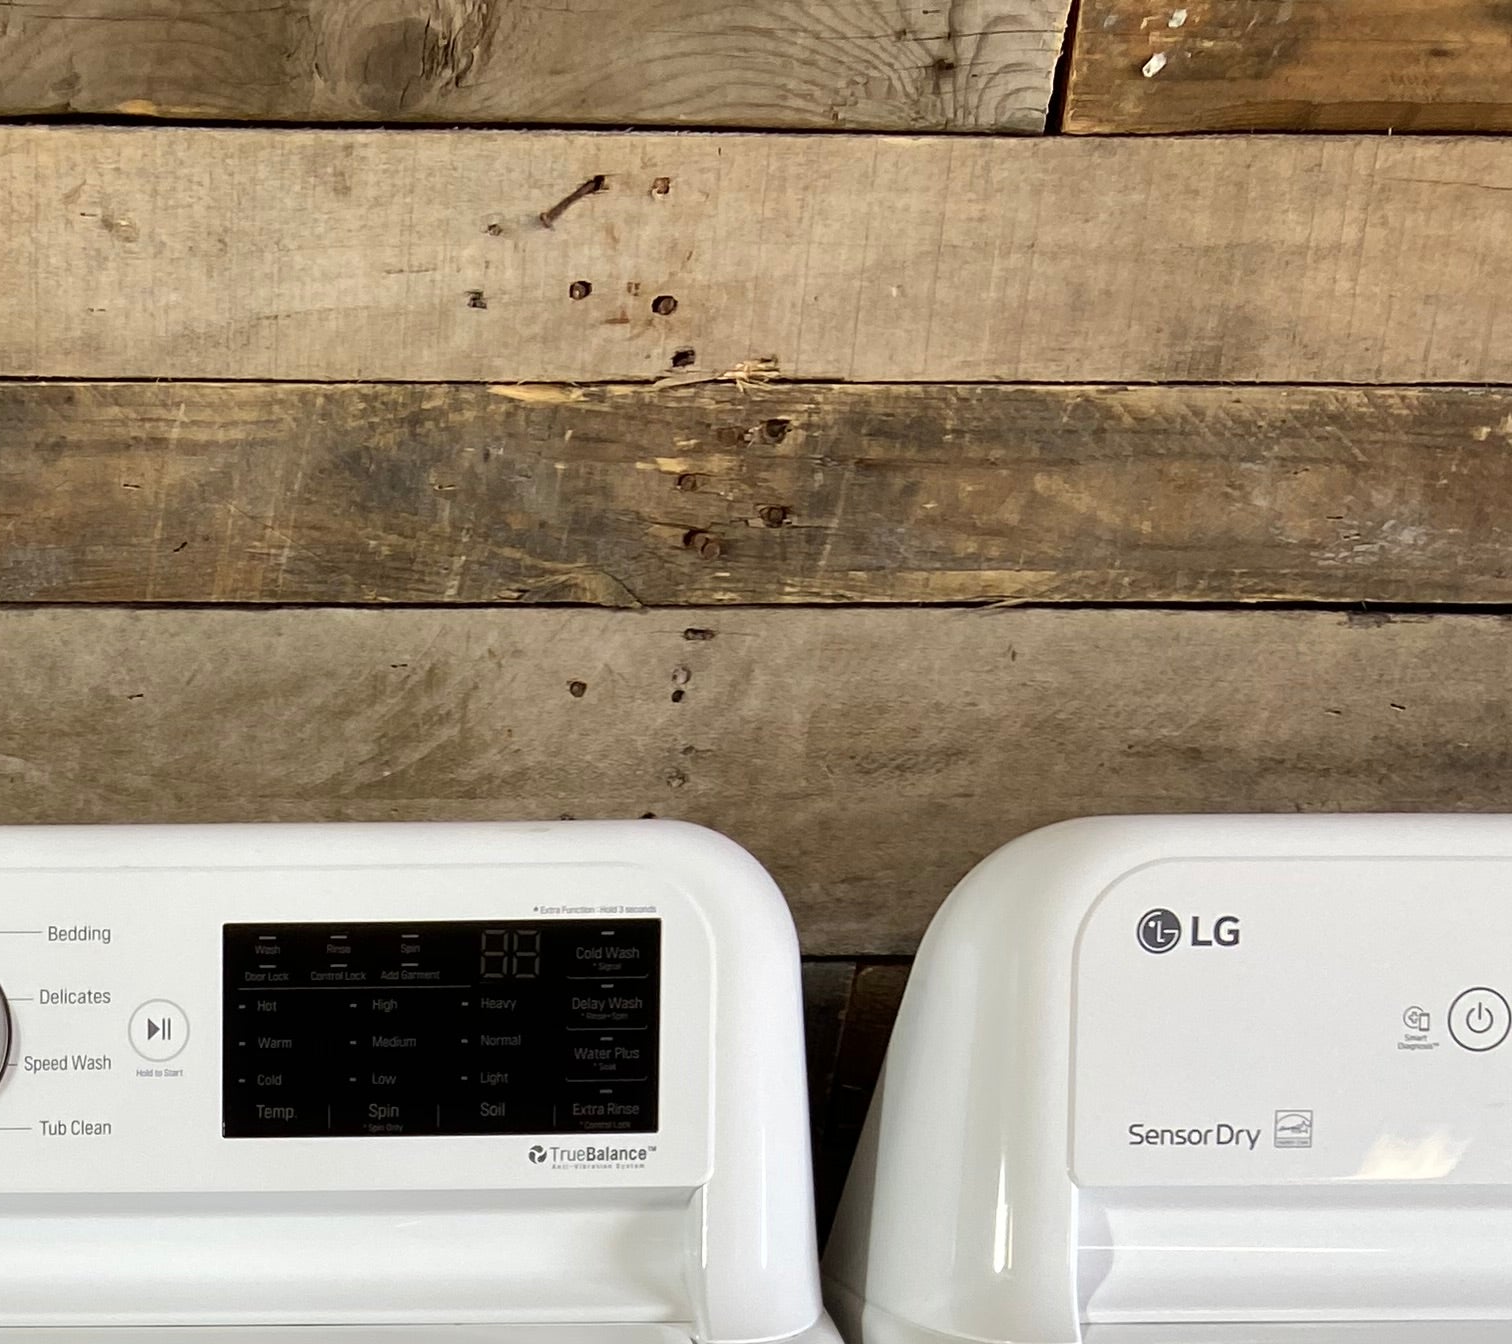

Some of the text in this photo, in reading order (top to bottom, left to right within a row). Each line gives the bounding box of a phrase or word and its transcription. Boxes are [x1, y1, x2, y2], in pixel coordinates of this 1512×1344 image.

[48, 926, 112, 944] Bedding
[1191, 915, 1240, 947] LG
[255, 945, 280, 954] Wash
[327, 944, 351, 954] Rinse
[401, 944, 421, 954] Spin
[576, 947, 640, 959] Cold Wash
[40, 989, 112, 1005] Delicates
[257, 1001, 277, 1012] Hot
[373, 1000, 398, 1012] High
[481, 998, 517, 1011] Heavy
[572, 997, 643, 1011] Delay Wash
[258, 1037, 292, 1049] Warm
[373, 1036, 416, 1048] Medium
[481, 1035, 521, 1046] Normal
[574, 1048, 640, 1060] Water Plus
[24, 1055, 112, 1074] Speed Wash
[136, 1069, 153, 1077] Hold
[164, 1069, 183, 1077] Start
[480, 1072, 508, 1085] Light
[257, 1075, 282, 1086] Cold
[372, 1074, 397, 1085] Low
[256, 1104, 297, 1121] Temp.
[368, 1103, 400, 1120] Spin
[480, 1102, 506, 1117] Soil
[573, 1102, 640, 1115] Extra Rinse
[40, 1120, 112, 1136] Tub Clean
